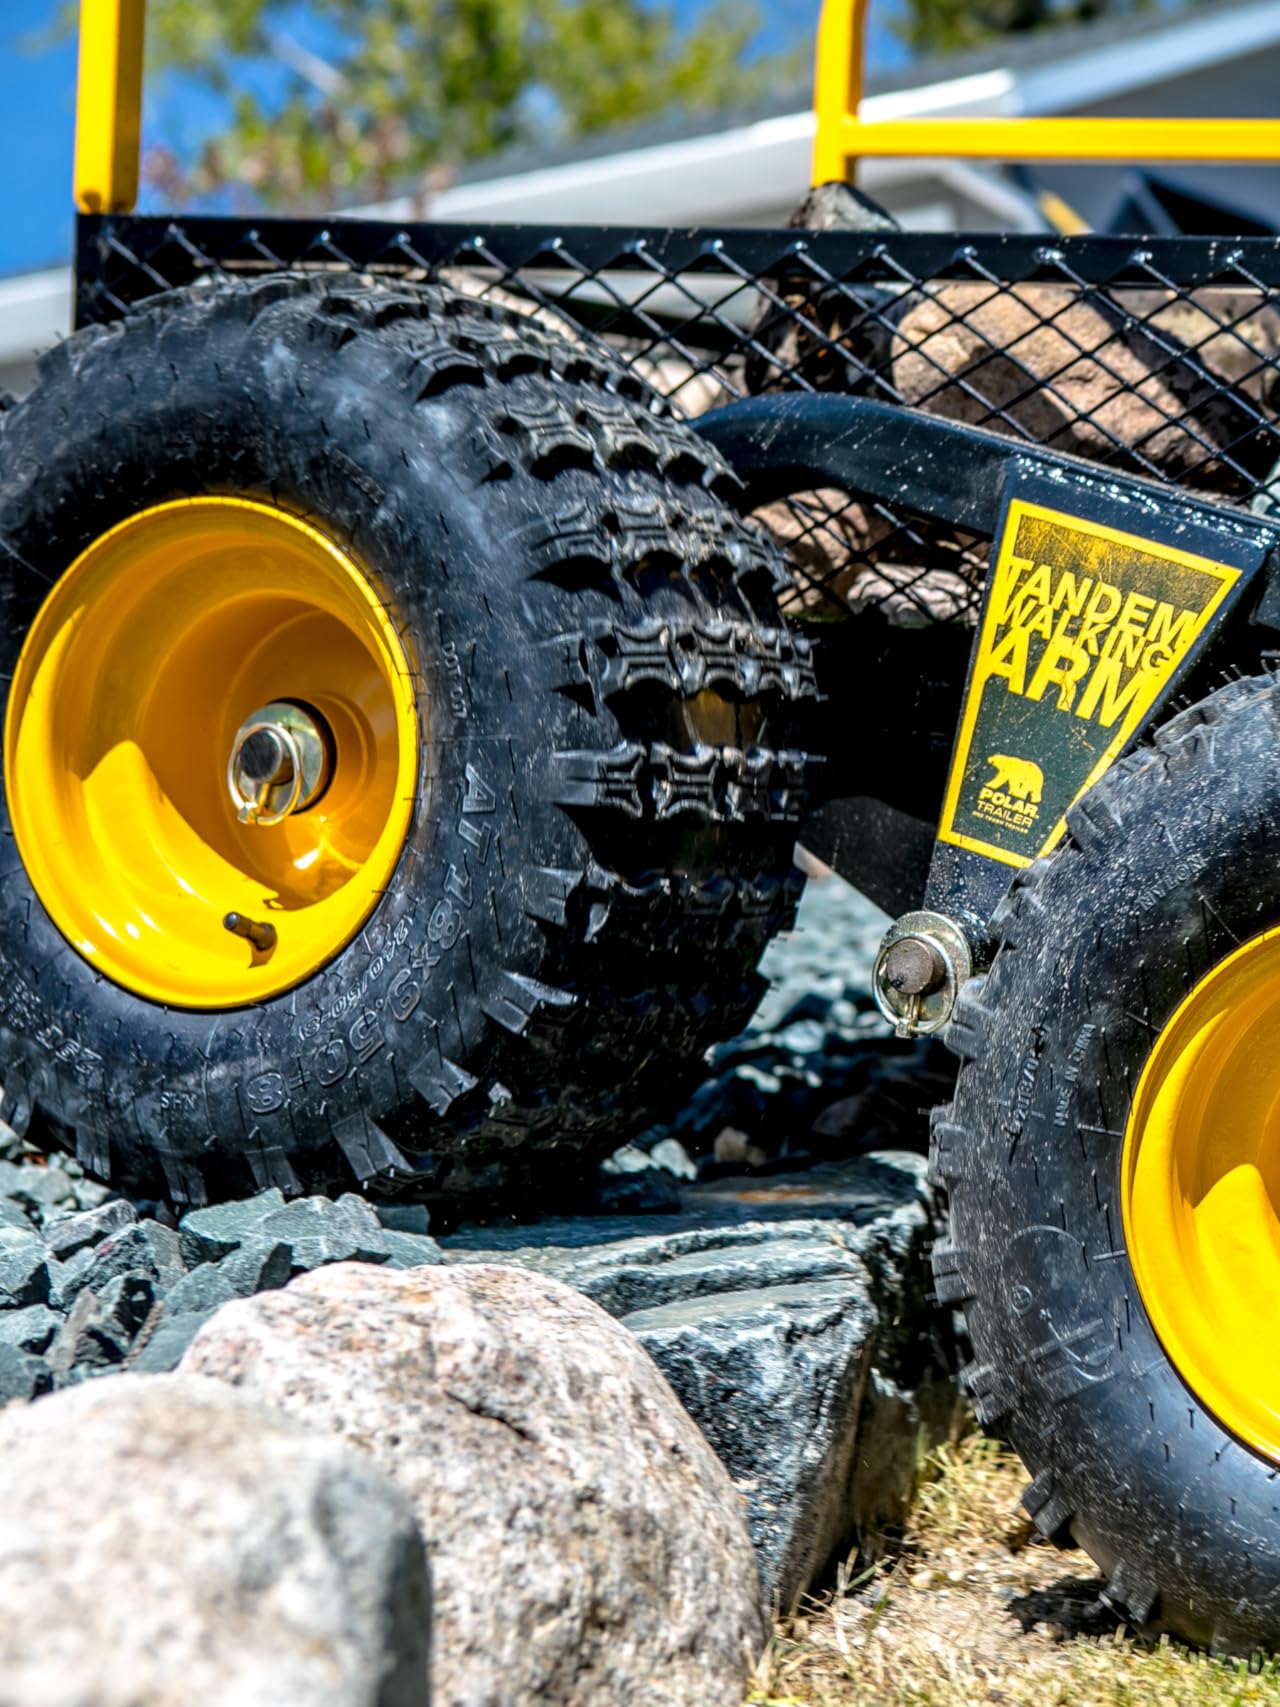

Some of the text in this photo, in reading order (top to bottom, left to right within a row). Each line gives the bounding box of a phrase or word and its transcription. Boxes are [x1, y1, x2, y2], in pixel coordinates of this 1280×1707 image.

[999, 594, 1175, 675] WALKING
[1003, 555, 1199, 648] TANDEM
[443, 642, 460, 676] DOT
[985, 626, 1152, 728] ARM
[977, 800, 1033, 828] TRAILER
[978, 787, 1039, 819] POLAR
[1138, 853, 1207, 912] NYLON
[1053, 1022, 1097, 1127] MADE IN CHINA
